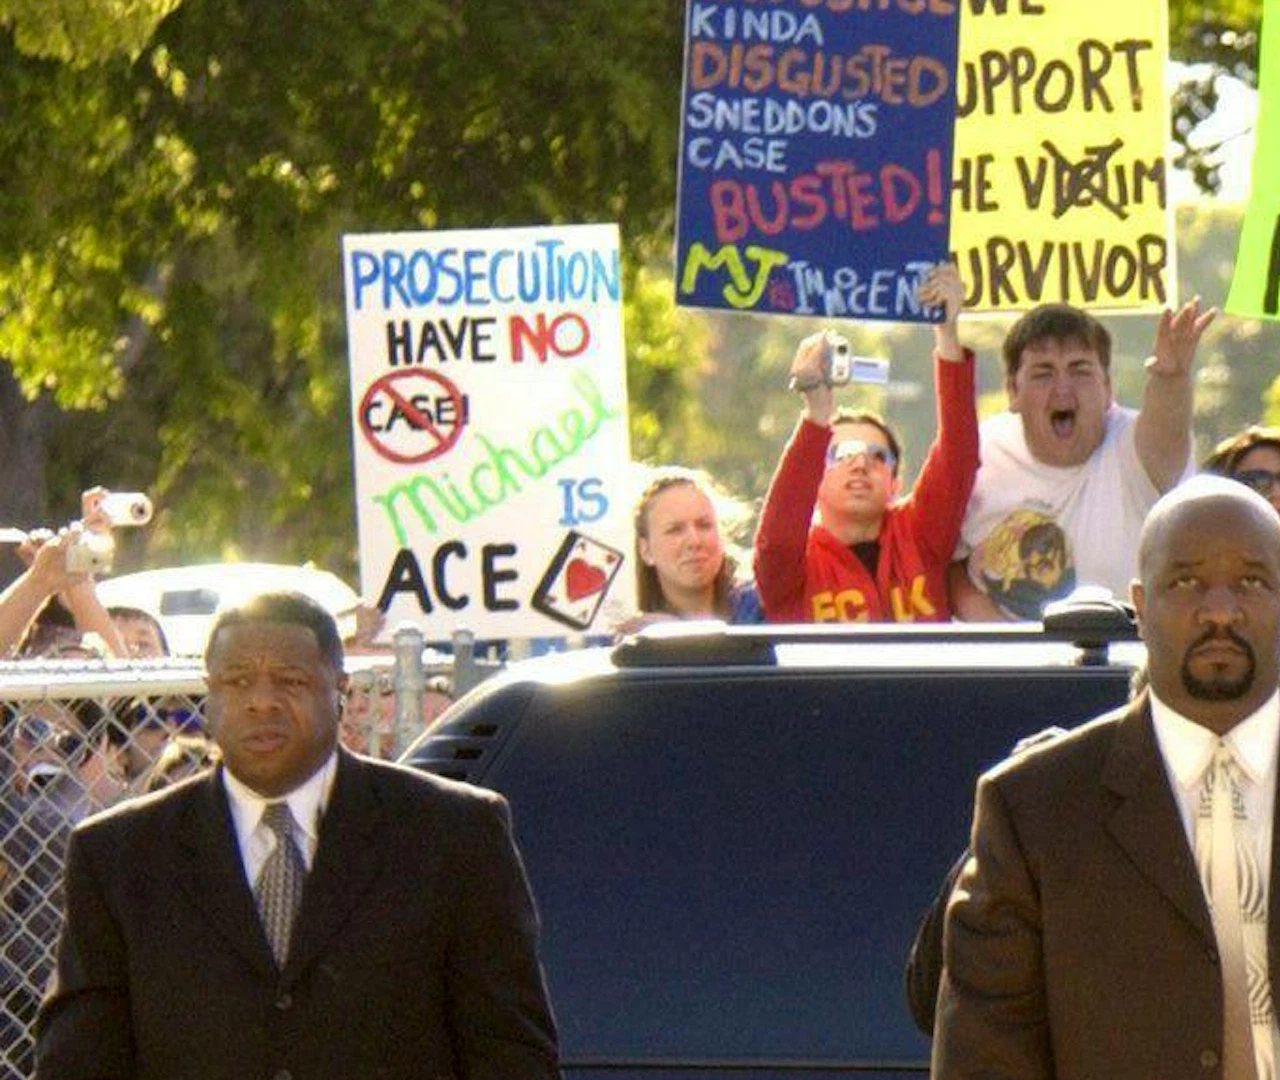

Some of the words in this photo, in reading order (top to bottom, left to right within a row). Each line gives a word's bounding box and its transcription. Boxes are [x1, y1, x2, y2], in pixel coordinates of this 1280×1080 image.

[691, 4, 823, 46] KINDA
[690, 41, 949, 107] DISGUSTED
[687, 137, 788, 173] CASE
[710, 148, 944, 243] BUSTED!
[351, 239, 620, 310] PROSECUTION
[681, 241, 789, 309] MJ
[386, 317, 497, 366] HAVE
[509, 312, 591, 364] NO
[558, 478, 609, 526] IS
[376, 540, 520, 614] ACE
